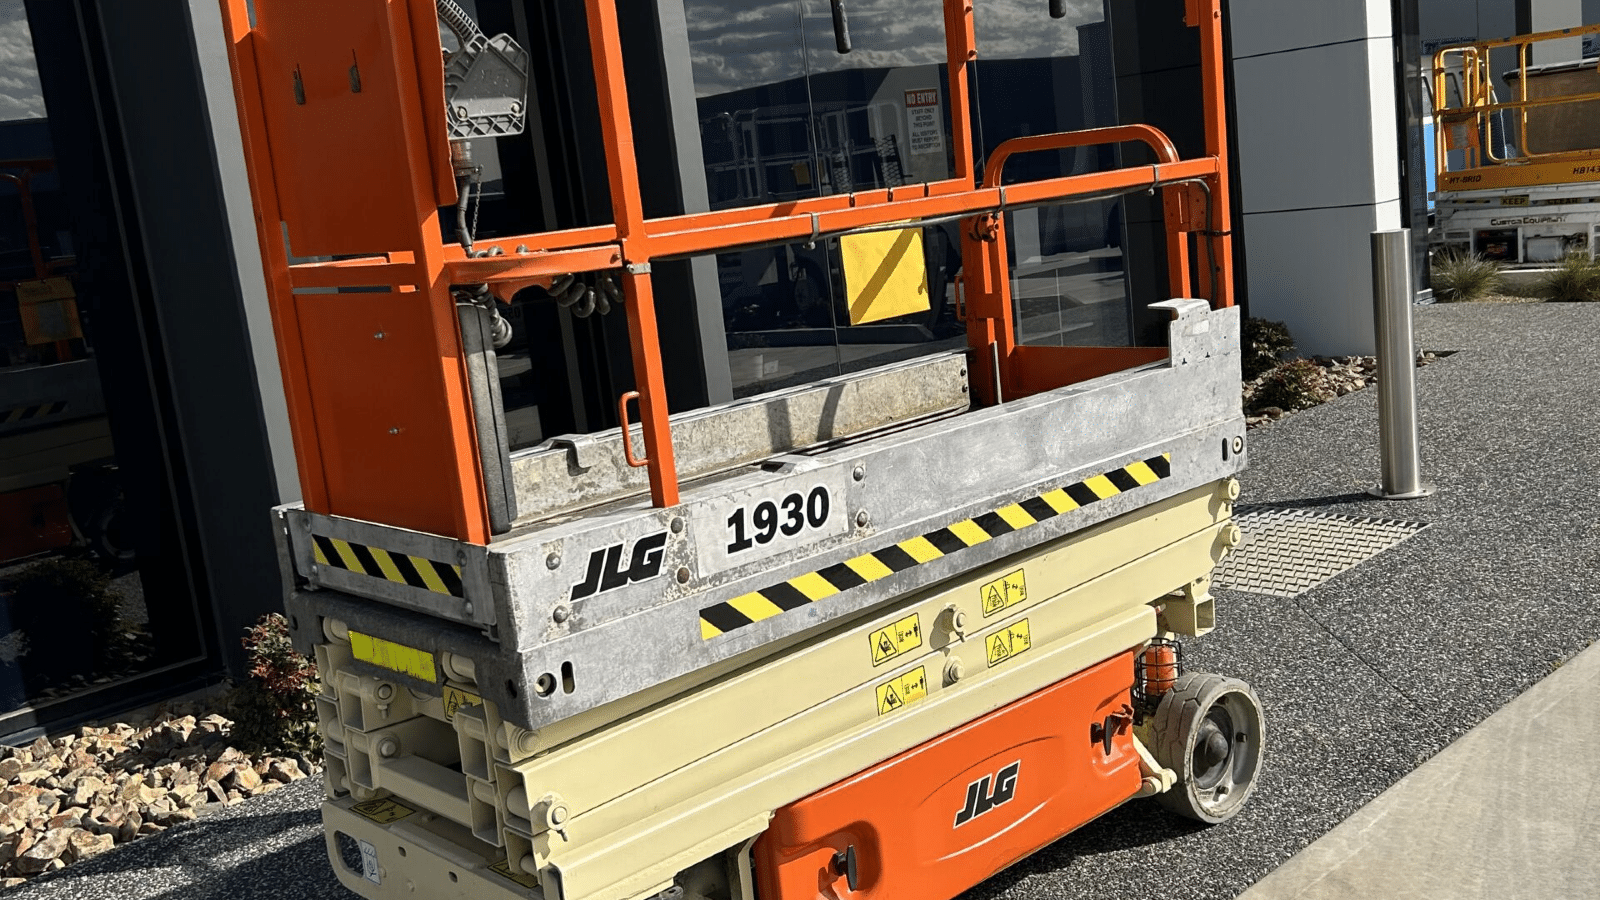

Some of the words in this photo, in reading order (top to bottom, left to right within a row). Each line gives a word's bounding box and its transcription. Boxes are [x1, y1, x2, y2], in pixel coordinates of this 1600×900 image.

[906, 93, 916, 105] NO
[916, 91, 936, 104] ENTRY
[1449, 175, 1482, 184] HY-BRID
[727, 486, 830, 554] 1930
[569, 530, 669, 602] JLG
[953, 759, 1021, 829] JLG
